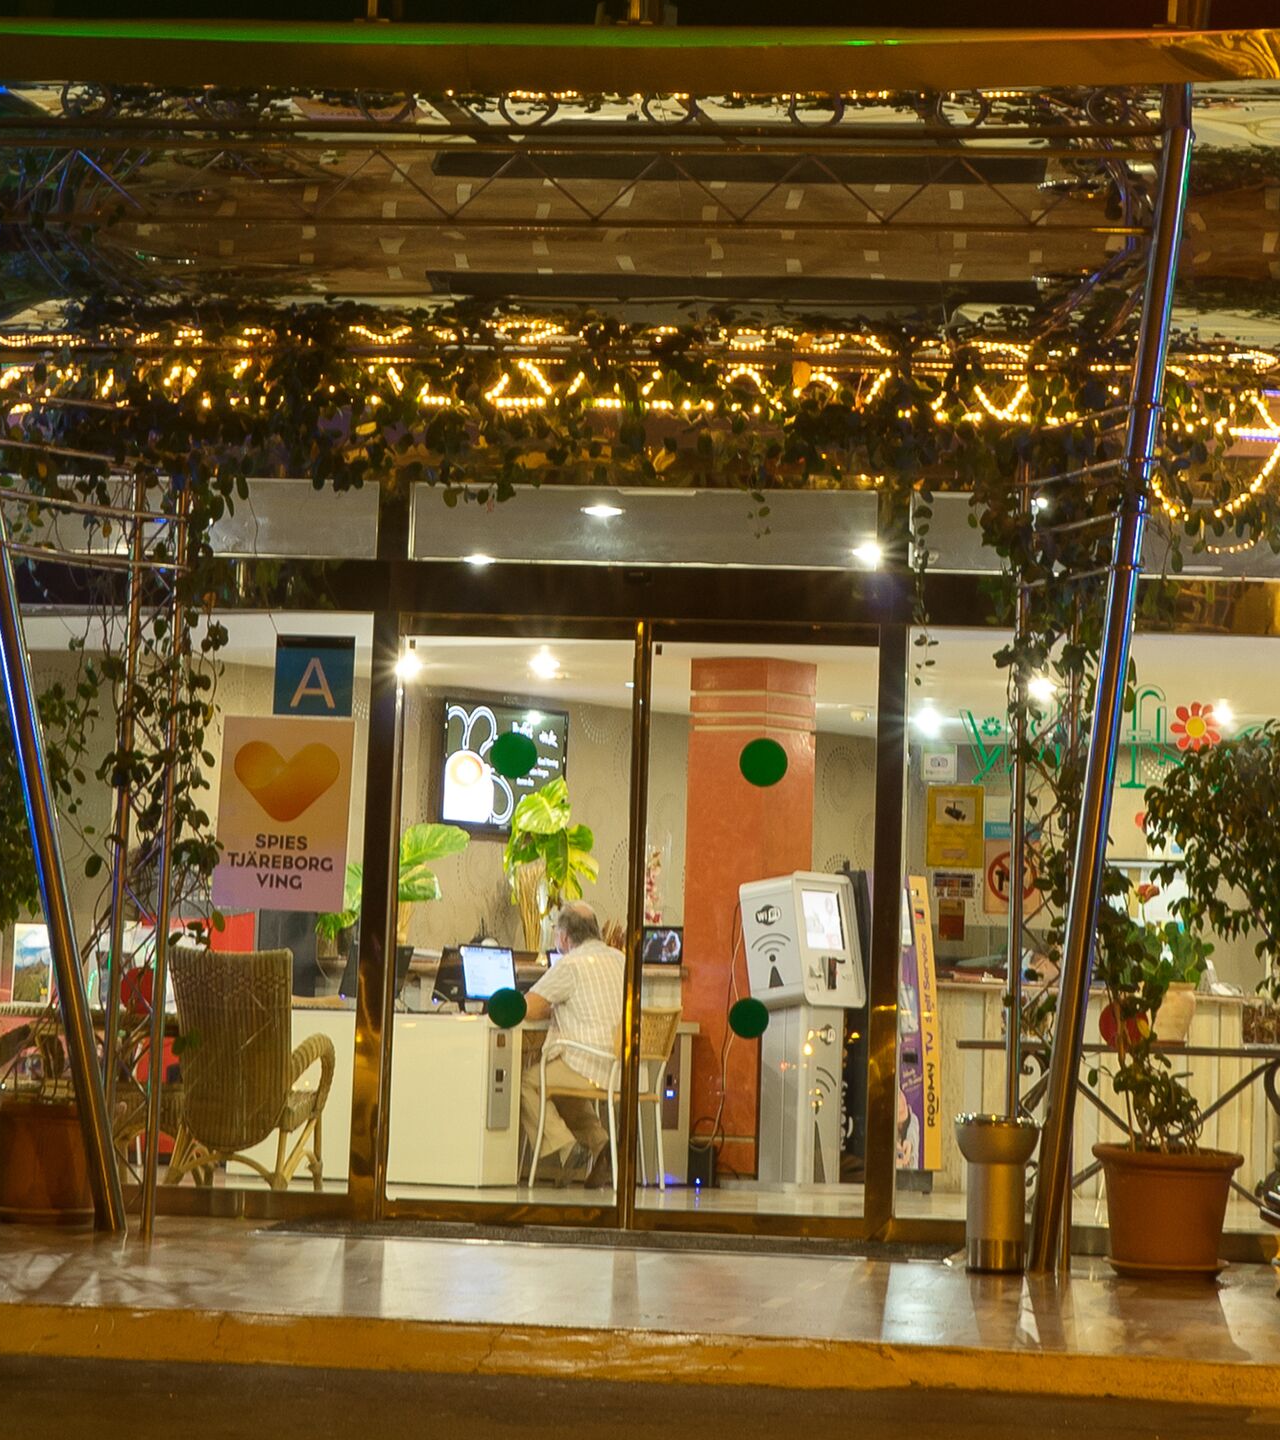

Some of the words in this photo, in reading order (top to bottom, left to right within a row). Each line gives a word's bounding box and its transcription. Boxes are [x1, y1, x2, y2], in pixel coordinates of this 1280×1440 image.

[290, 657, 336, 709] A
[255, 834, 308, 851] SPIES
[228, 850, 334, 872] TJÄREBORG
[256, 873, 303, 889] VING
[920, 933, 931, 990] Service
[925, 1032, 934, 1056] TV
[927, 1062, 939, 1128] ROOMY
